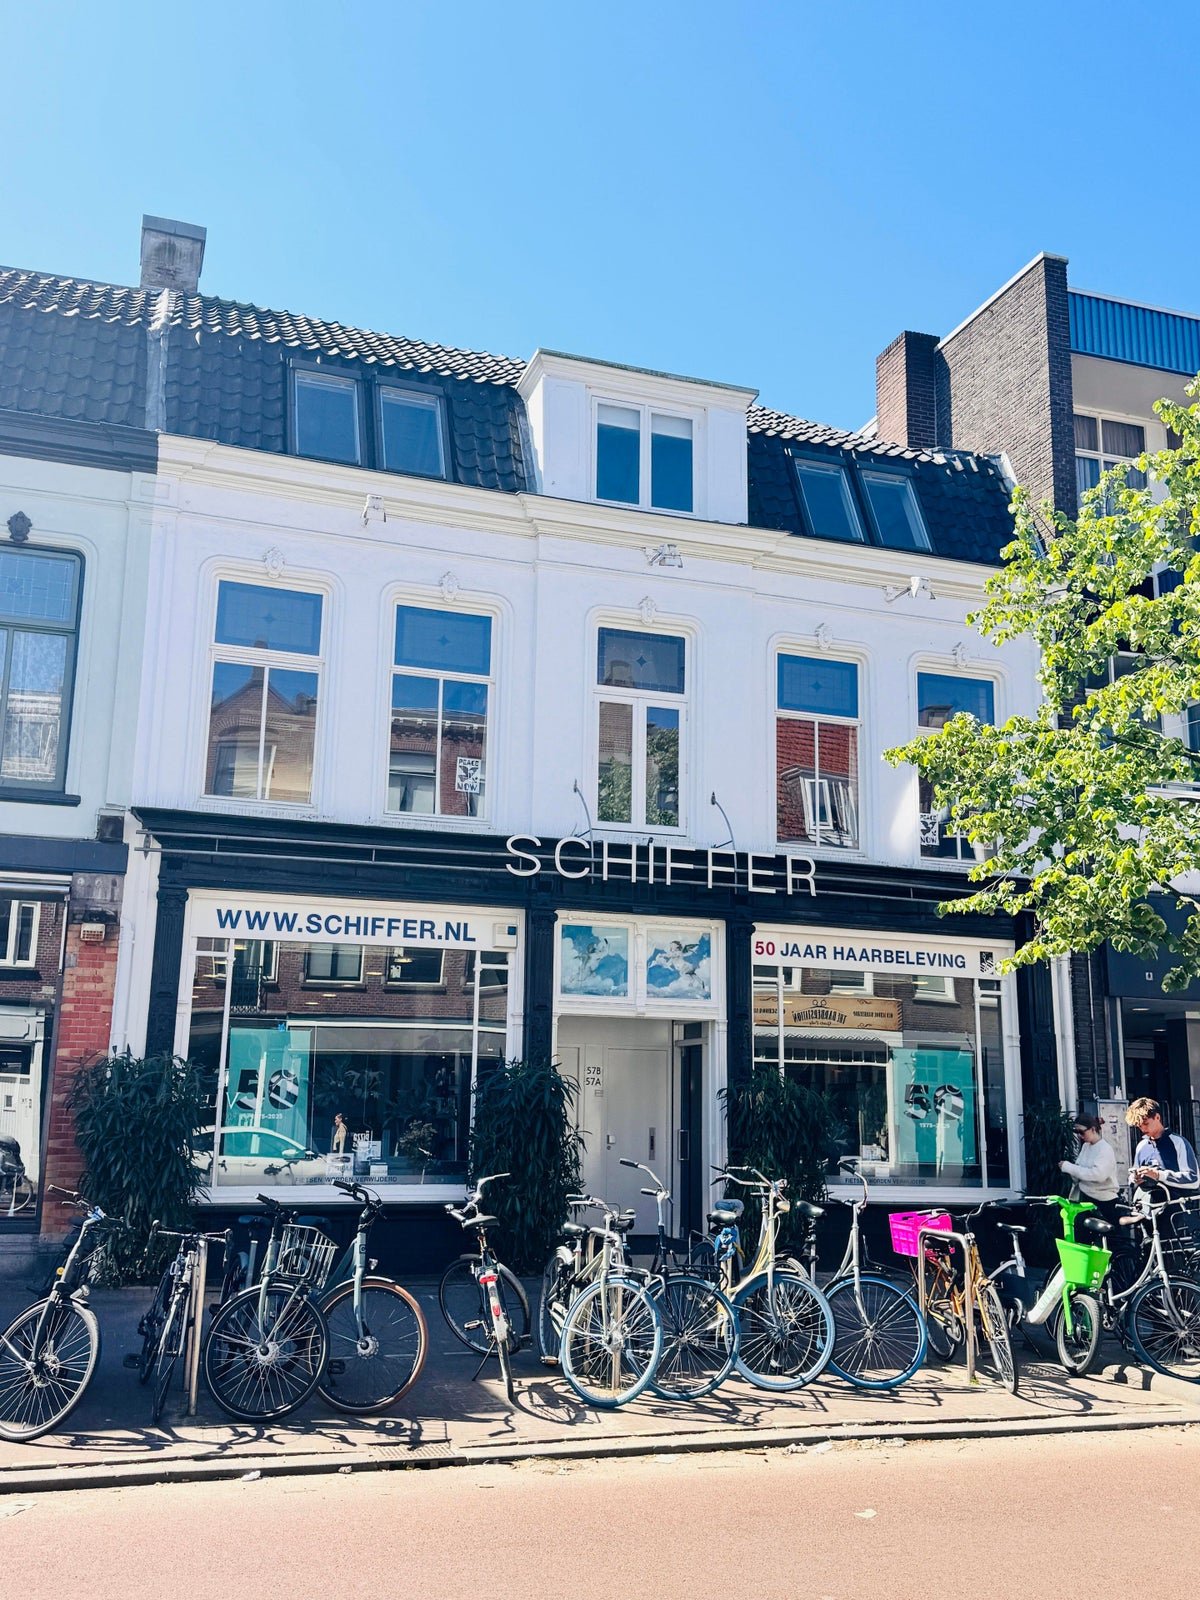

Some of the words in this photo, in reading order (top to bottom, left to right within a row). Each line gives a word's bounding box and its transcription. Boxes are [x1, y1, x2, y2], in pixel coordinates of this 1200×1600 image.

[459, 758, 479, 767] PEACE
[457, 782, 478, 791] NOW
[505, 834, 817, 897] SCHIFFER
[216, 908, 477, 942] WWW.SCHIFFER.NL
[754, 941, 776, 956] 50
[780, 942, 828, 960] JAAR
[833, 946, 967, 969] HAARBELEVING
[586, 1066, 602, 1075] 57B
[585, 1077, 602, 1086] 57A
[903, 1084, 965, 1120] 50
